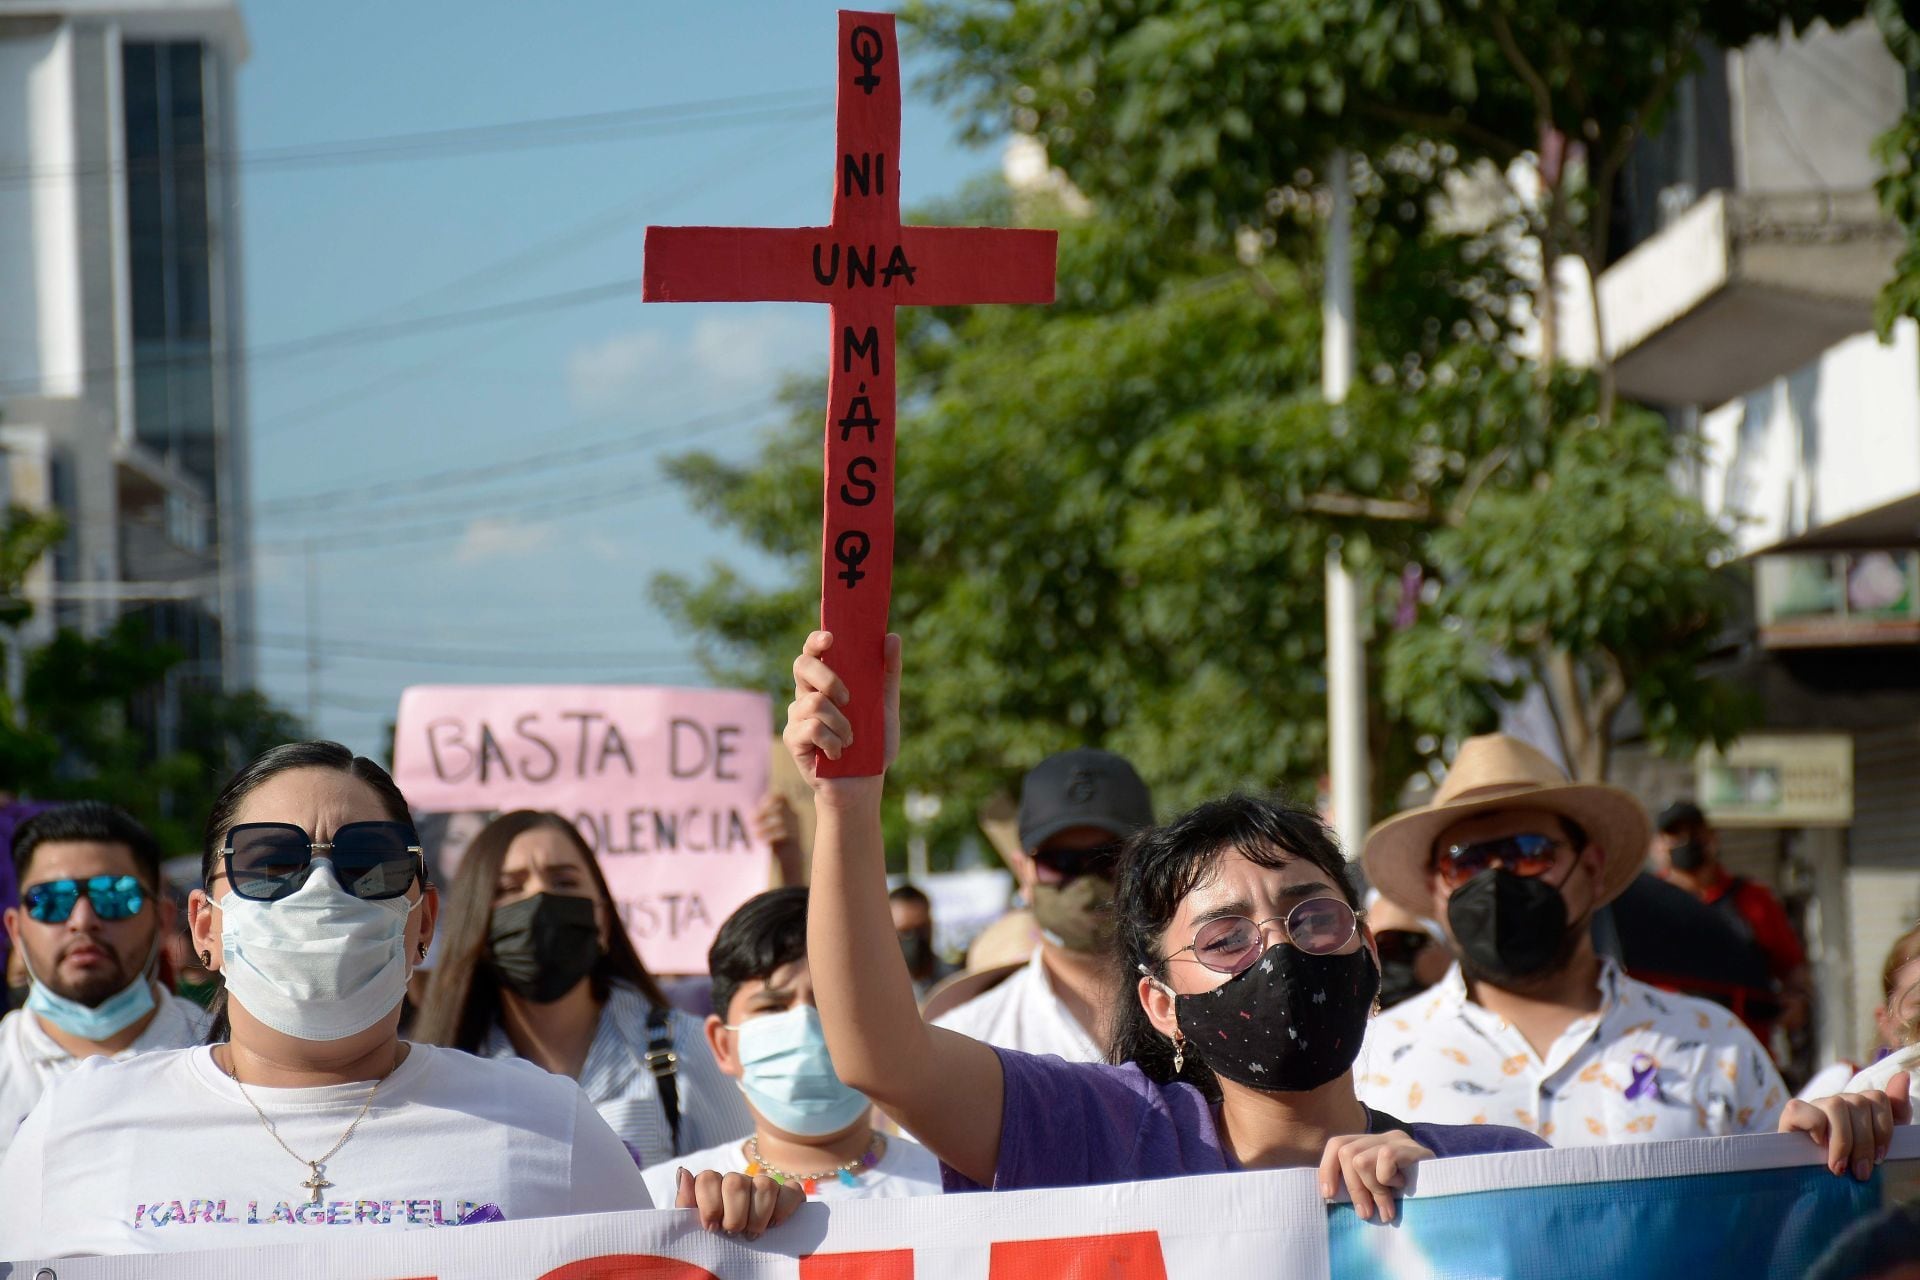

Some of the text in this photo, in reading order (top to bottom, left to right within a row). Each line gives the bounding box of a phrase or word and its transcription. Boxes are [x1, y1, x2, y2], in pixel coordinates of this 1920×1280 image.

[843, 152, 884, 197] NI
[812, 243, 917, 289] UNA
[426, 711, 745, 785] BASTA DE
[575, 805, 754, 855] OLENCIA
[135, 1199, 240, 1229] KARL
